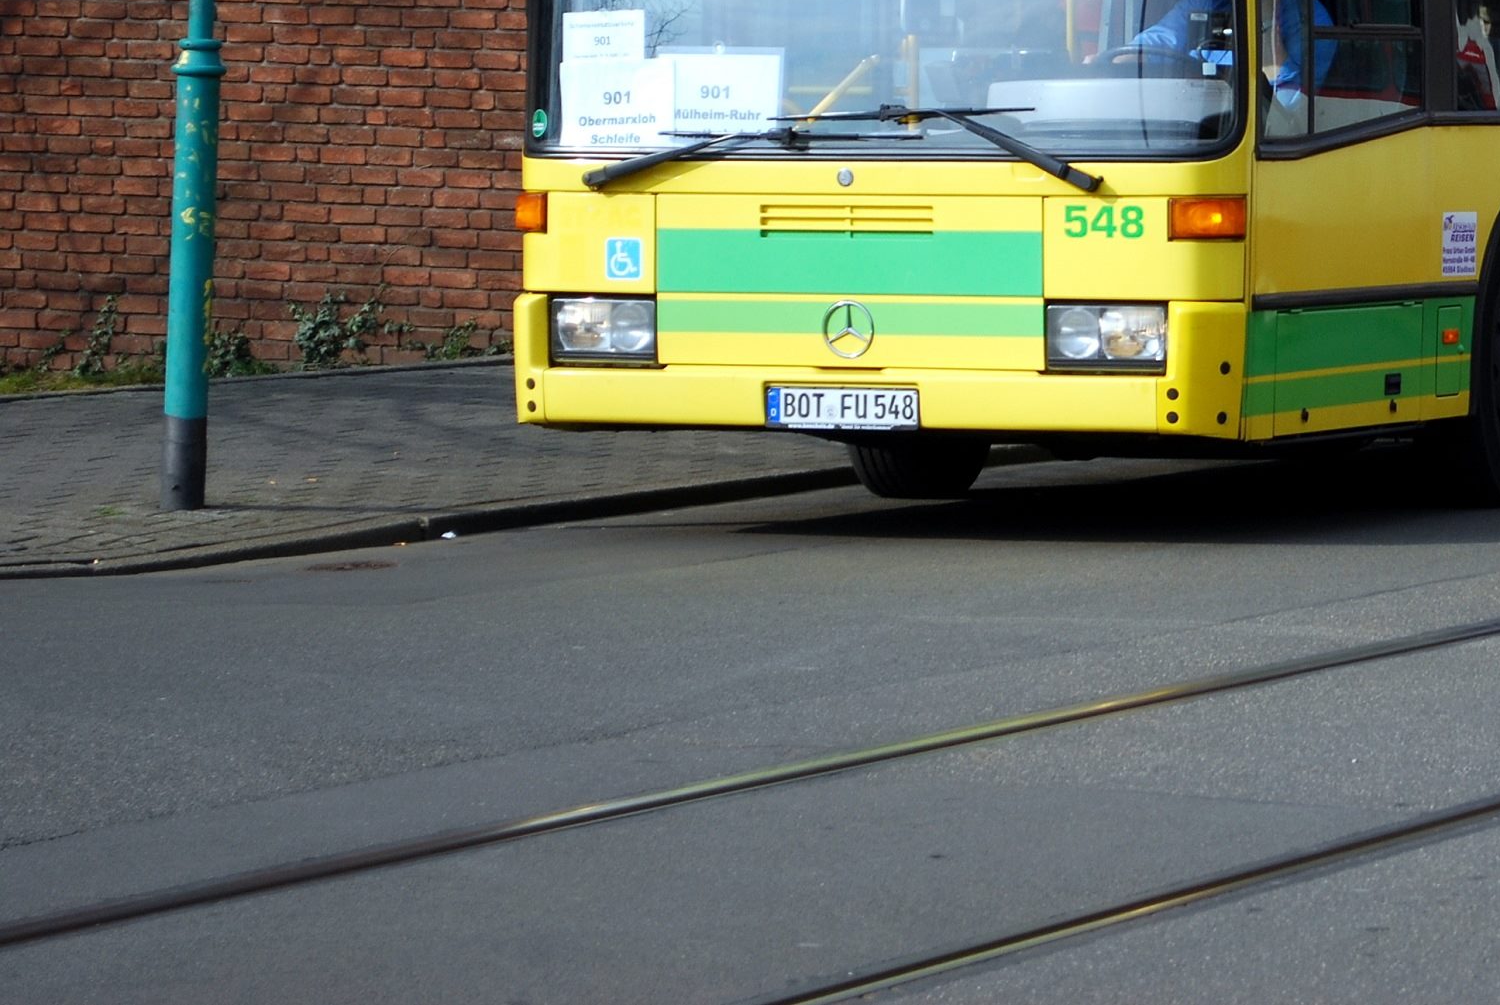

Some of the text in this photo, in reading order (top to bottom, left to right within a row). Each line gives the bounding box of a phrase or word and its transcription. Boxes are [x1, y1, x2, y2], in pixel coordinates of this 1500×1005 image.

[594, 36, 611, 46] 901
[603, 91, 631, 105] 901
[700, 85, 730, 99] 901
[578, 113, 656, 127] Obermarxloh
[590, 133, 641, 145] Schleife
[1064, 205, 1145, 238] 548
[1450, 233, 1475, 243] REISEN
[783, 392, 825, 418] BOT
[840, 393, 867, 419] FU
[874, 394, 914, 420] 548
